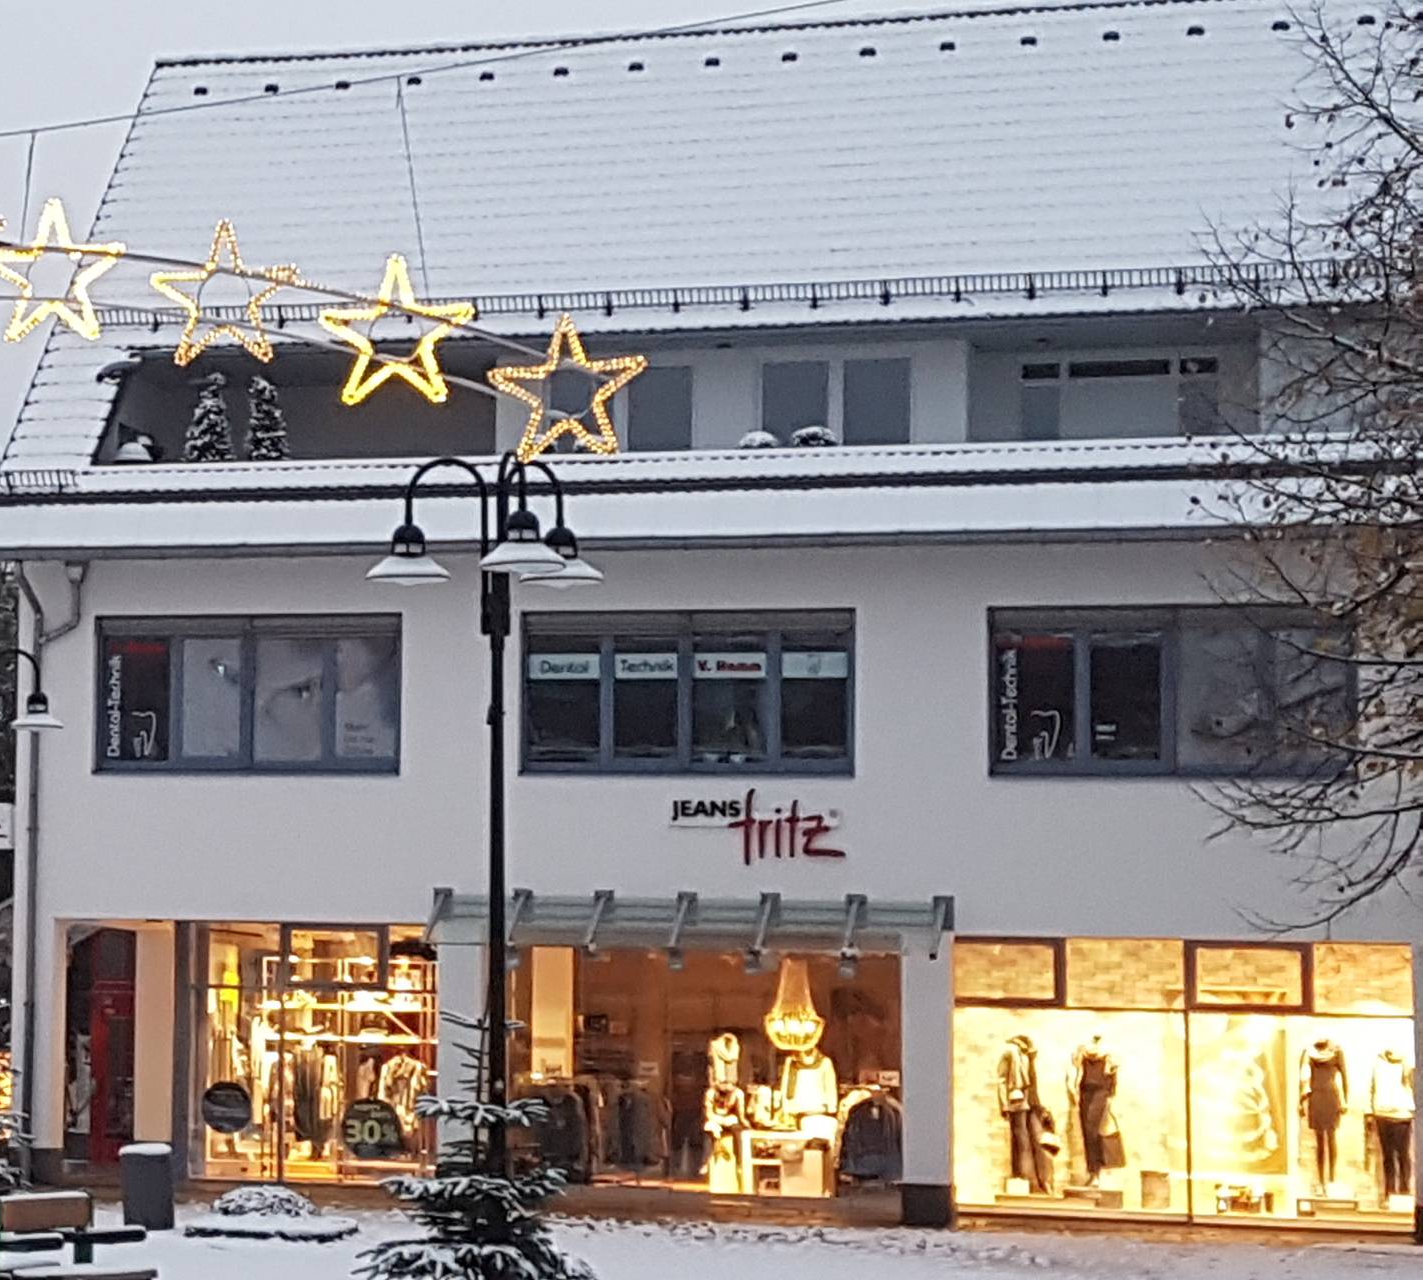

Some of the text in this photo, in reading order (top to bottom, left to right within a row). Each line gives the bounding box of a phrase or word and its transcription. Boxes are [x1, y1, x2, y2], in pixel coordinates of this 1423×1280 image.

[540, 659, 590, 675] Dental
[620, 658, 674, 673] Technik
[671, 788, 846, 866] JEANS fritz
[345, 1118, 398, 1145] 30%
